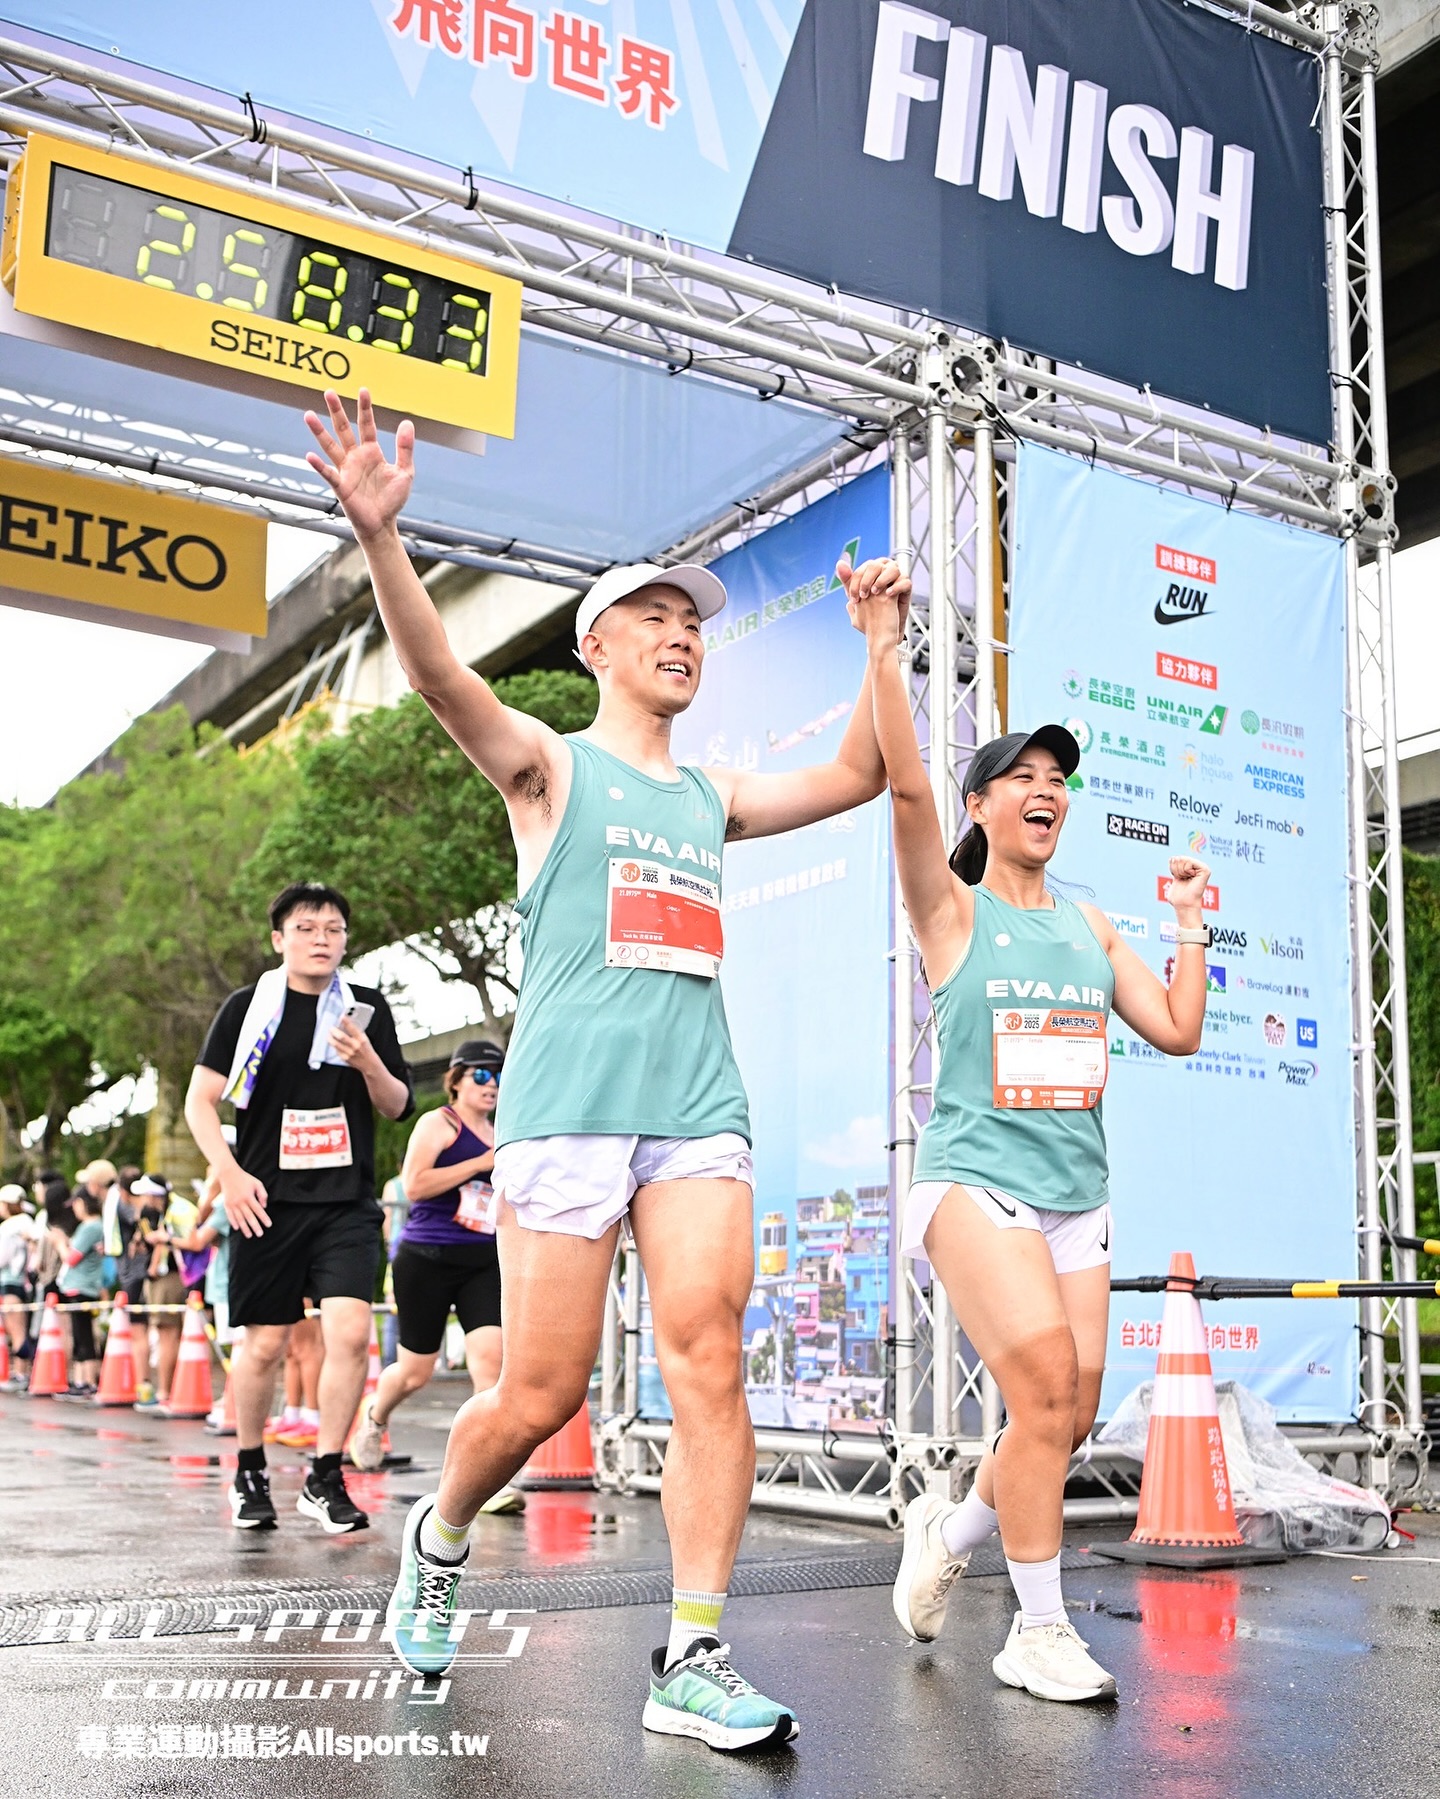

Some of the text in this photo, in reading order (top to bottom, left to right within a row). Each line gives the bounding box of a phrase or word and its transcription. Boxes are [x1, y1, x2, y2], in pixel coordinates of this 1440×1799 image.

[863, 0, 1255, 291] FINISH
[210, 320, 351, 380] SEIKO
[1160, 549, 1213, 579] 訓練夥伴
[762, 574, 827, 628] 長榮航空
[1165, 583, 1208, 614] RUN
[1161, 656, 1214, 686] 協力夥伴
[1088, 690, 1136, 711] EGSC
[1147, 696, 1203, 718] UNI AIR
[1147, 709, 1190, 728] 立榮航空
[1100, 746, 1166, 767] EVERGREEN HOTELS
[1201, 751, 1224, 767] halo
[1201, 763, 1234, 781] house
[1244, 763, 1304, 787] AMERICAN
[1090, 775, 1154, 800] 國泰世華銀行
[1253, 778, 1306, 799] EXPRESS
[1169, 791, 1220, 818] Relove
[1124, 818, 1168, 837] RACE ON
[1234, 810, 1263, 829] JetFi
[642, 872, 659, 884] 2025
[1259, 932, 1304, 960] Vilson
[1024, 1020, 1040, 1029] 2025
[1278, 1061, 1311, 1076] Power
[1207, 1426, 1228, 1512] 路跑協會
